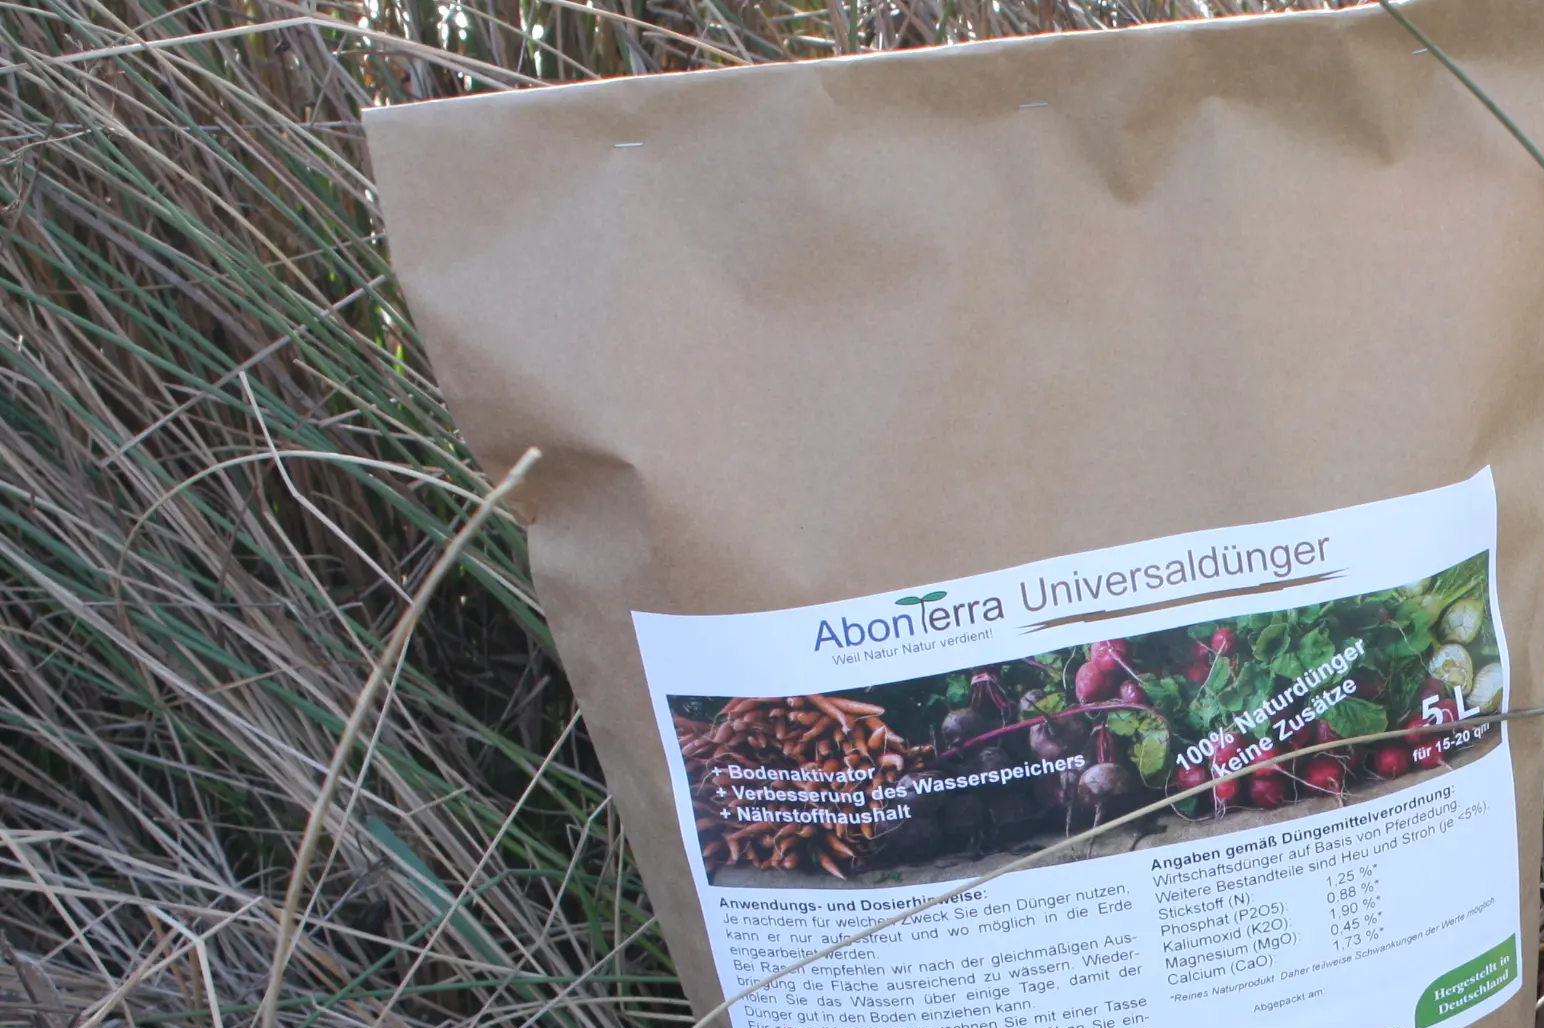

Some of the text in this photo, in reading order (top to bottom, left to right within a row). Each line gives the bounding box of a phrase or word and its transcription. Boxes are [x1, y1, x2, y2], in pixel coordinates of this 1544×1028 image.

[1020, 536, 1331, 613] Universaldünger
[831, 626, 993, 666] Weil Natur Natur verdient!
[1176, 639, 1366, 771] 100% Naturdünger
[1422, 684, 1480, 728] 5 L
[1213, 678, 1357, 777] keine Zusätze
[1412, 722, 1490, 762] für 15-20 qm
[728, 764, 875, 783] Bodenaktivator
[732, 754, 1085, 806] Verbesserung des Wasserspeichers
[737, 804, 911, 825] Nährstoffhaushalt
[1150, 784, 1455, 871] Angaben gemäß Düngemittelverordnung:
[1152, 852, 1284, 888] Wirtschaftsdünger
[1288, 843, 1310, 860] auf
[1314, 835, 1353, 854] Basis
[1355, 827, 1381, 842] von
[1154, 885, 1212, 904] Weitere
[1215, 864, 1304, 893] Bestandteile
[1308, 854, 1337, 872] sind
[1340, 848, 1369, 864] Heu
[1373, 835, 1398, 854] und
[1401, 824, 1436, 845] Stroh
[1439, 818, 1454, 834] (je
[1324, 868, 1355, 888] 1,25
[1326, 885, 1357, 904] 0,88
[719, 896, 856, 914] Anwendungs- und
[722, 912, 739, 925] Je
[742, 914, 808, 928] nachdem
[811, 915, 831, 928] für
[953, 906, 978, 920] Sie
[983, 903, 1011, 916] den
[1016, 893, 1071, 911] Dünger
[1075, 884, 1130, 901] nutzen,
[725, 899, 1132, 943] kann er nur und wo möglich in die Erde
[1158, 891, 1254, 920] Stickstoff (N):
[1160, 901, 1288, 937] Phosphat (P2O5):
[1328, 901, 1358, 920] 1,90
[1162, 917, 1292, 953] Kaliumoxid (K2O):
[1330, 917, 1360, 936] 0,45
[1332, 933, 1362, 951] 1,73
[732, 934, 1137, 979] Bei empfehlen wir nach der gleichmäßigen Aus-
[1164, 930, 1302, 970] Magnesium (MgO):
[1167, 953, 1277, 986] Calcium (CaO):
[785, 965, 1142, 1008] Sie das Wässern über einige Tage, damit der
[802, 979, 824, 991] die
[830, 979, 879, 992] Fläche
[886, 972, 976, 991] ausreichend
[983, 971, 1001, 983] zu
[1008, 961, 1074, 979] wässern.
[1081, 949, 1140, 967] Wieder-
[1434, 955, 1510, 1001] Hergestellt in
[1253, 988, 1326, 1013] Abgepackt am:
[1438, 968, 1509, 1015] Deutschland
[743, 1000, 1035, 1024] Dünger gut in den Boden einziehen kann.
[1003, 1015, 1028, 1028] Sie
[1033, 1010, 1057, 1024] mit
[1062, 1005, 1099, 1020] einer
[1103, 997, 1147, 1012] Tasse
[1122, 1012, 1150, 1026] ein-
